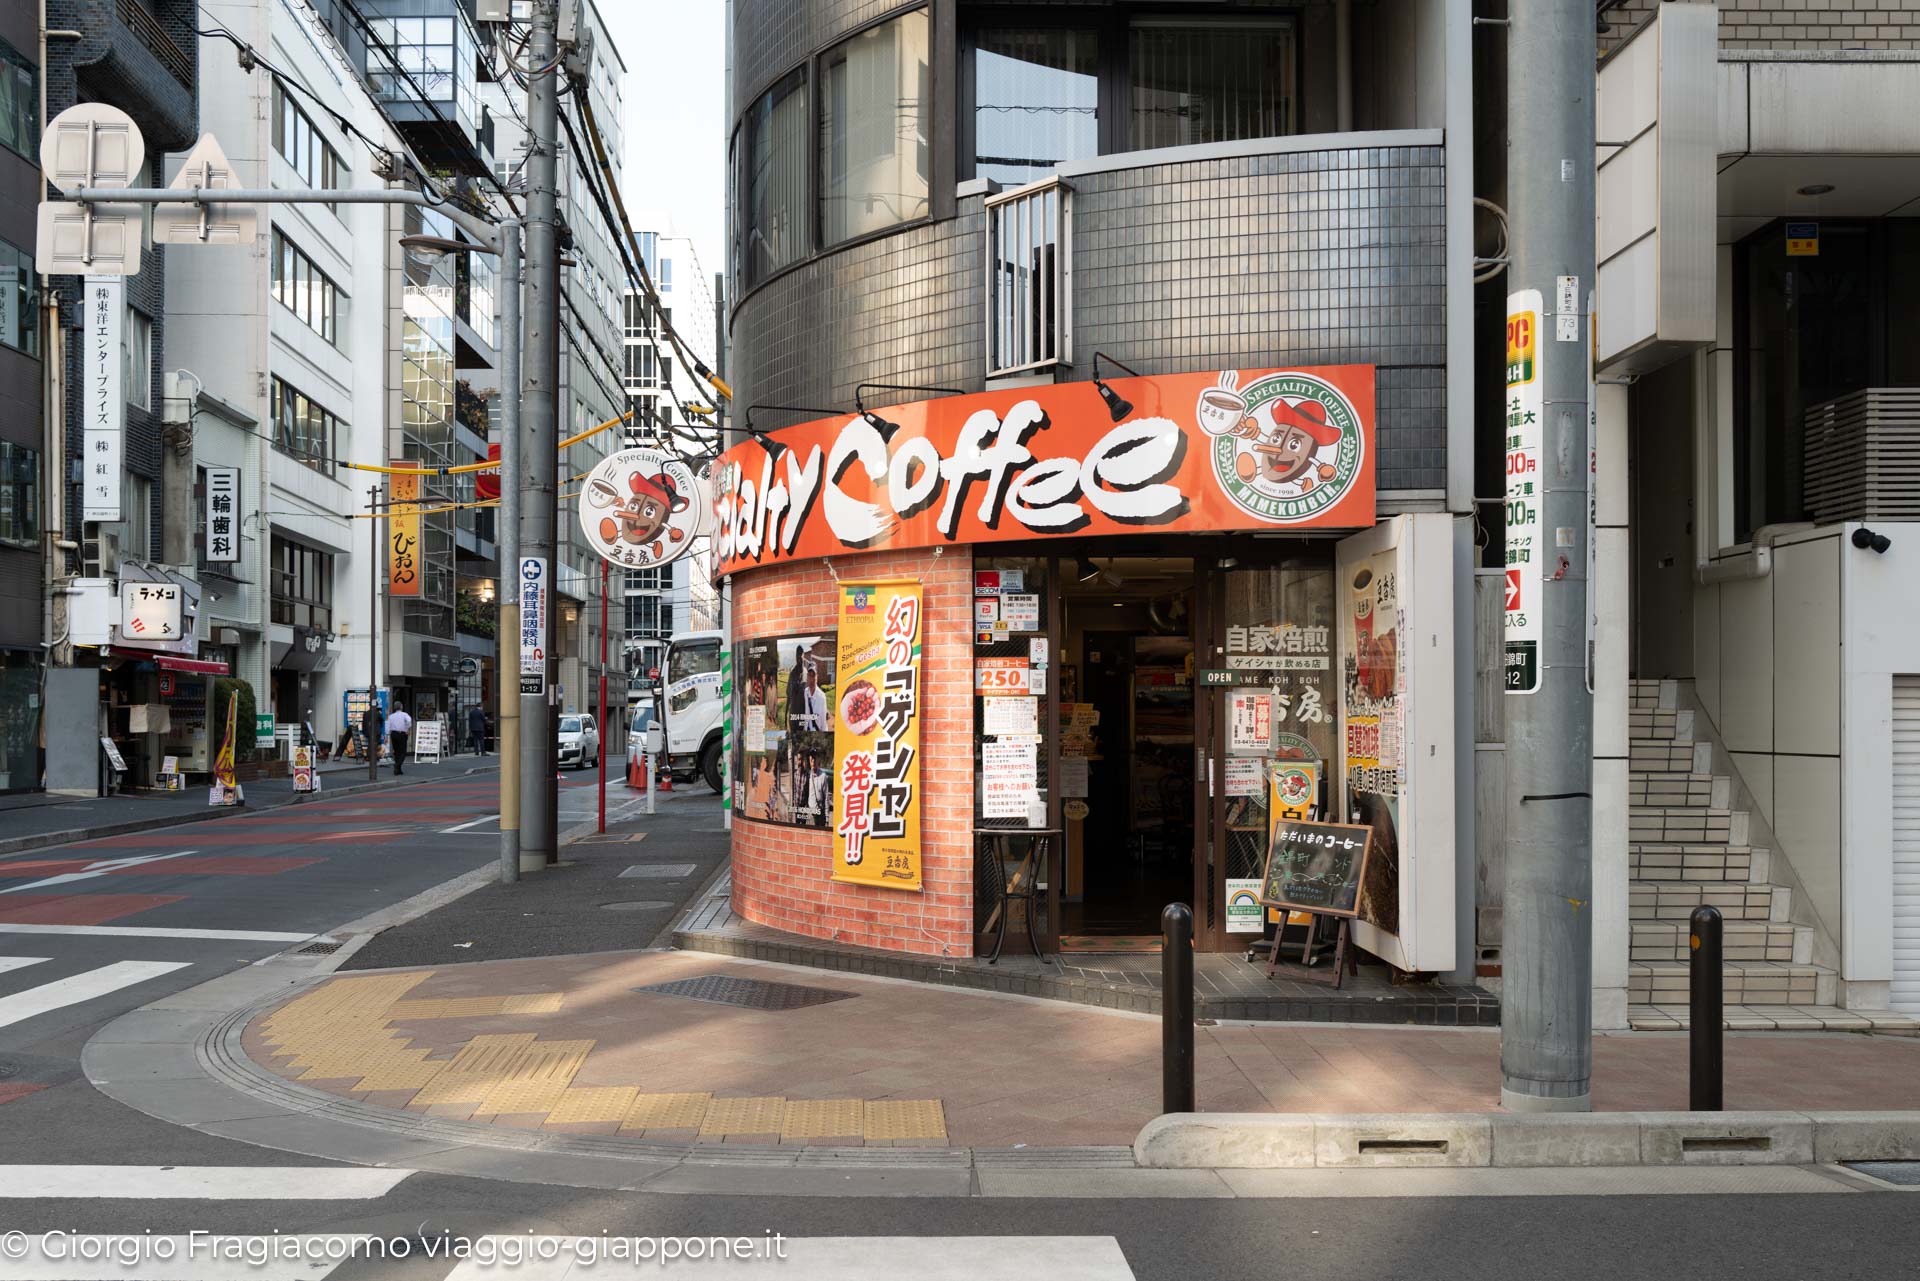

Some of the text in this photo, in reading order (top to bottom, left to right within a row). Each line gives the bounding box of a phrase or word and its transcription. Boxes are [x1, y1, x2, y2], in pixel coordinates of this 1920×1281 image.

[1246, 382, 1350, 428] SPECIALITY COFFEE
[666, 463, 689, 491] Coffee
[823, 400, 1187, 544] Coffee
[1237, 484, 1337, 516] MAMEKOHBOH
[212, 474, 231, 556] 三輪歯科
[393, 532, 416, 584] びおん
[610, 545, 650, 564] 豆香房
[140, 588, 175, 600] ラーメン
[522, 582, 538, 647] 内藤耳鼻咽喉科
[846, 615, 874, 624] ETHIOPIA
[1226, 624, 1329, 653] 自家焙煎
[858, 647, 880, 664] Gesha
[1234, 658, 1321, 669] ゲイシャが飲める店
[1207, 673, 1232, 682] OPEN
[1268, 676, 1289, 684] KOH
[1299, 676, 1320, 684] BOH
[1279, 830, 1364, 850] ただいまのコーヒー
[886, 855, 911, 870] 豆香房
